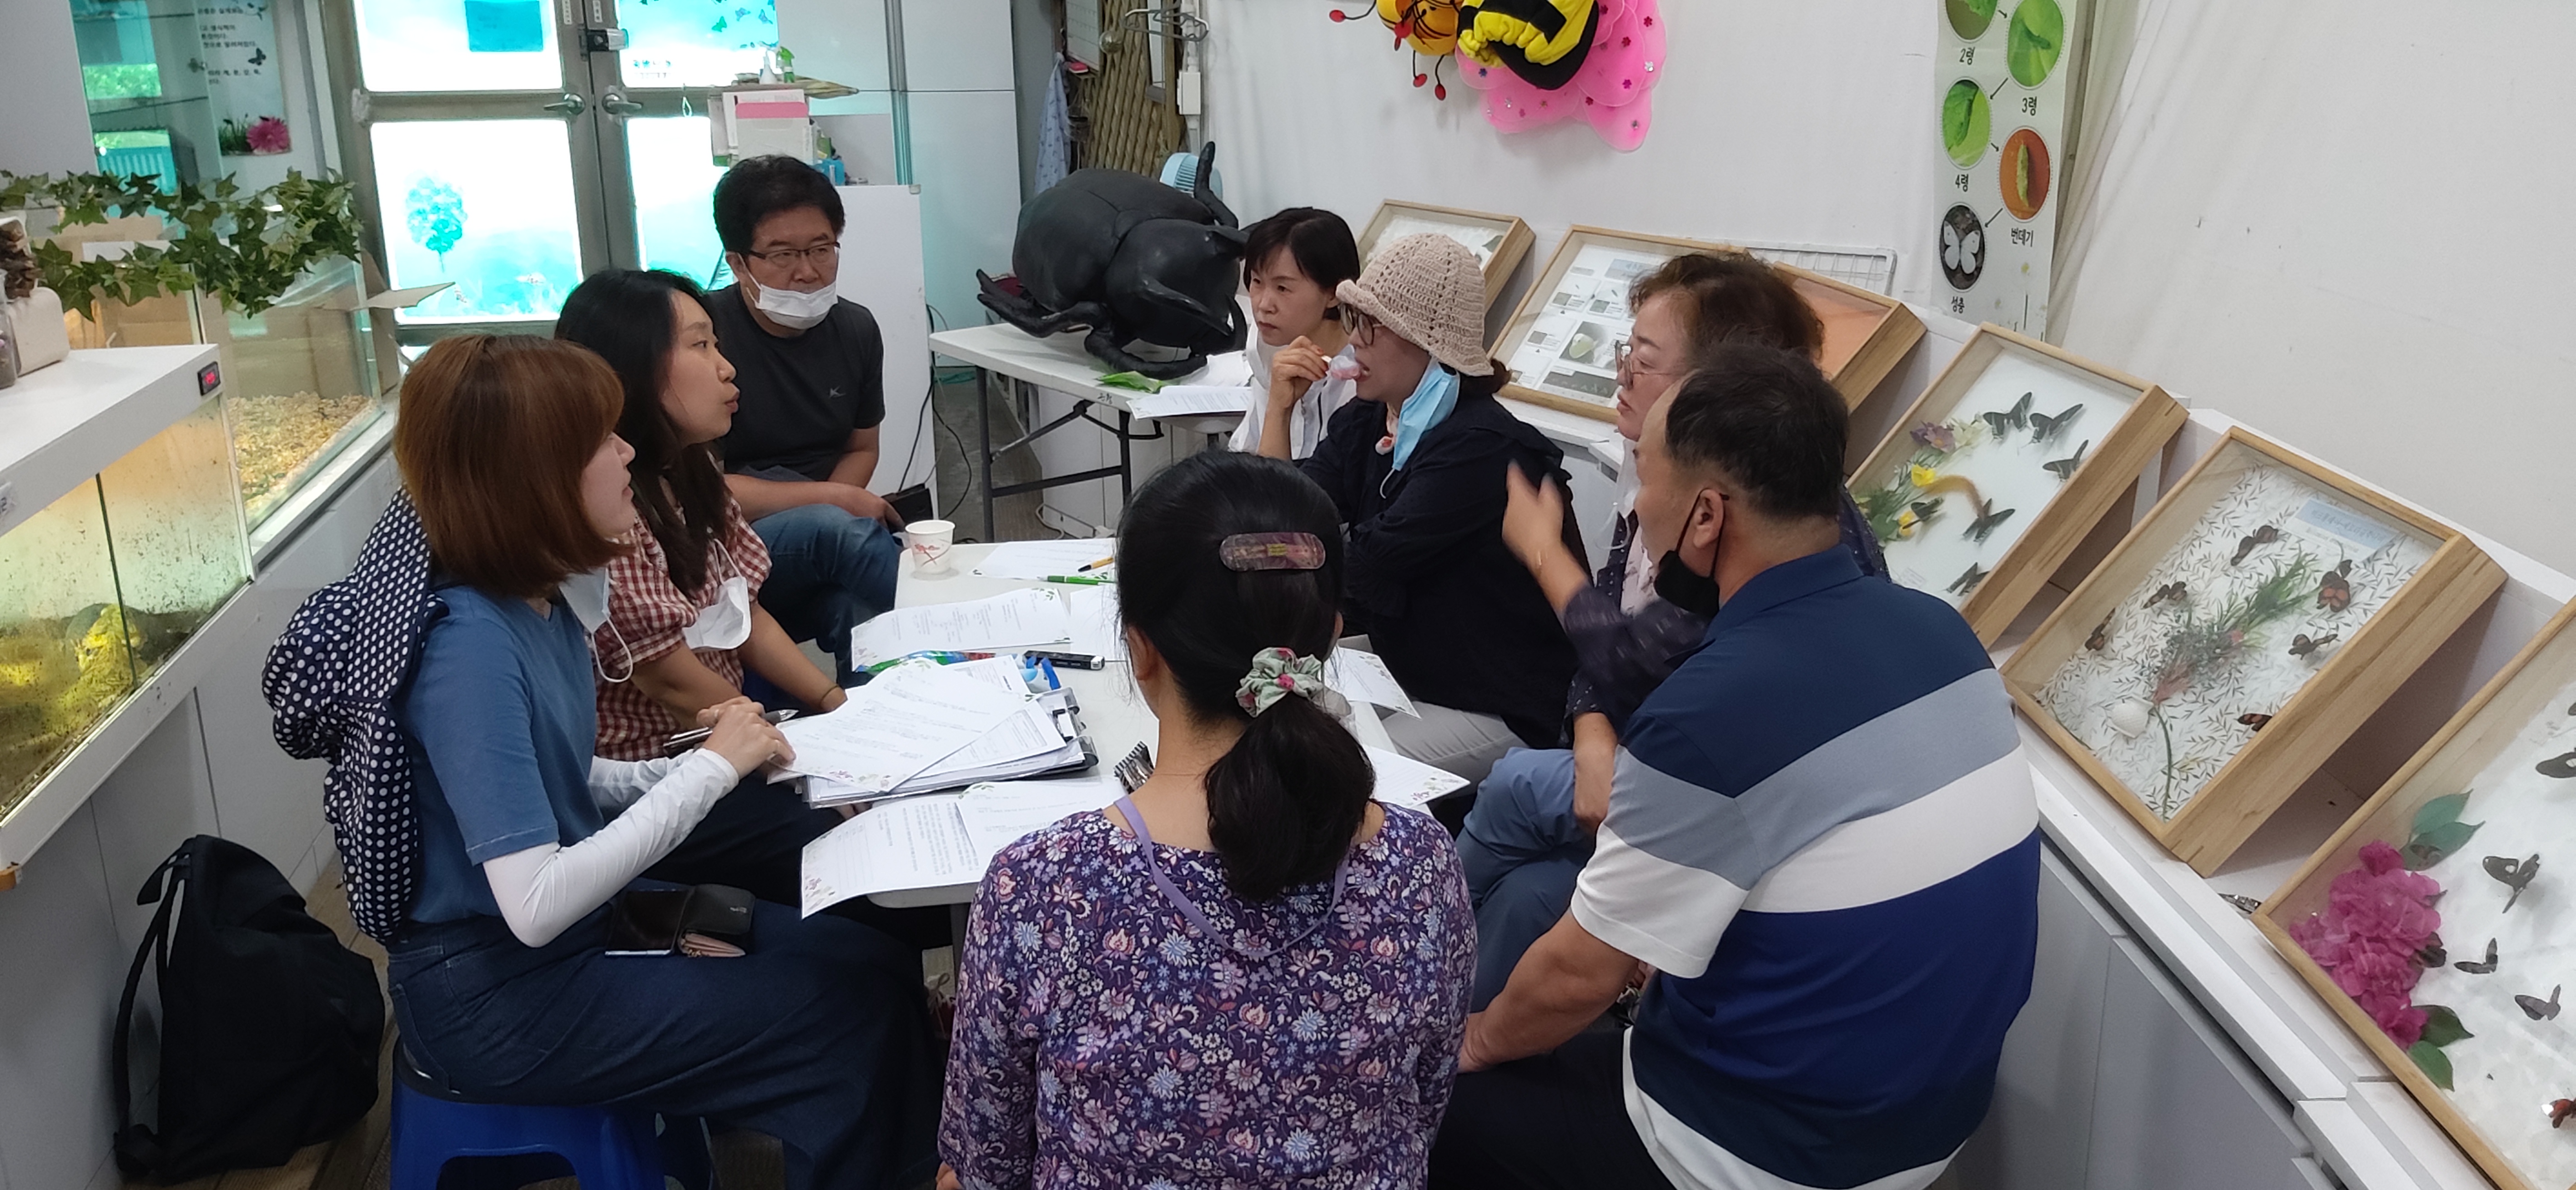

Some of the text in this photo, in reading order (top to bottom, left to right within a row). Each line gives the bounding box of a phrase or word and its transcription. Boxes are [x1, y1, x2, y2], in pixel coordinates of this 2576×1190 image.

[1959, 46, 1976, 66] 2령
[2022, 96, 2038, 116] 3령
[1955, 173, 1969, 192] 4령
[2011, 227, 2034, 247] 번데기
[1951, 296, 1965, 314] 성충
